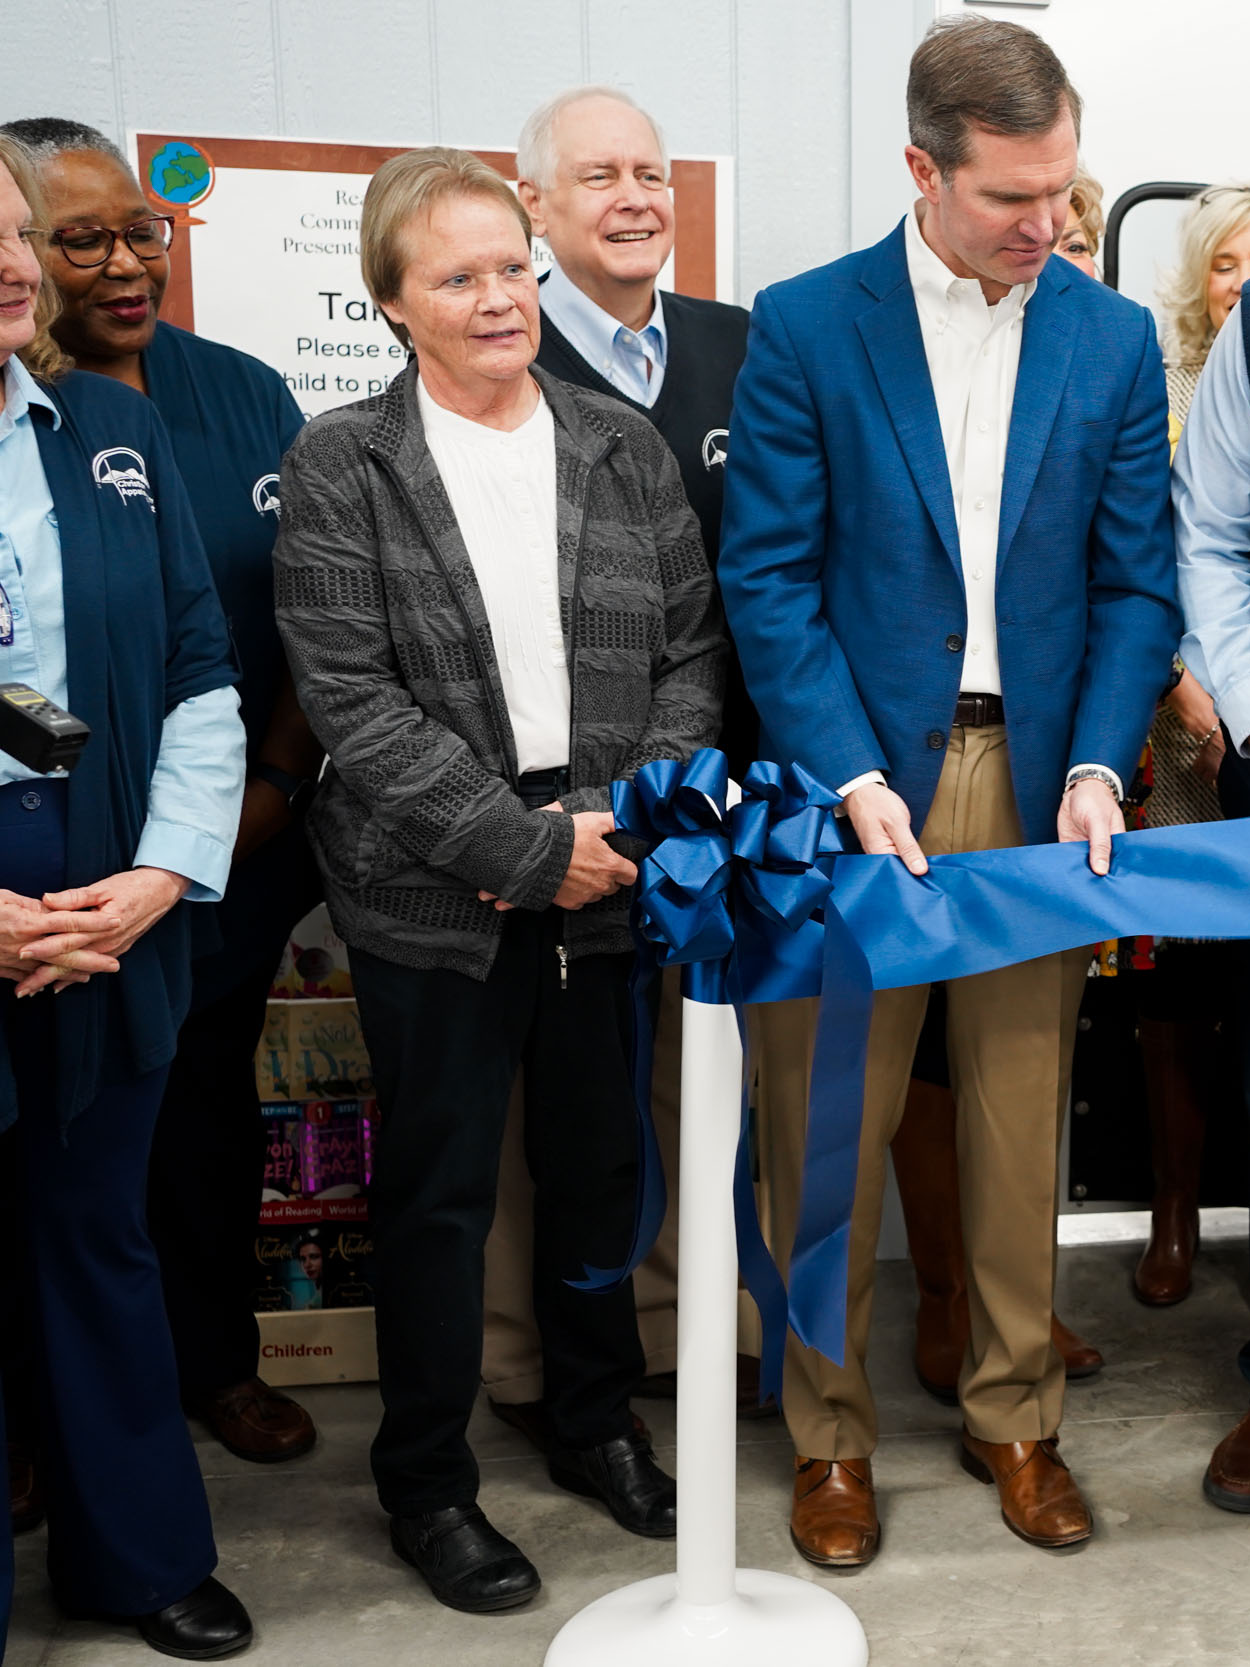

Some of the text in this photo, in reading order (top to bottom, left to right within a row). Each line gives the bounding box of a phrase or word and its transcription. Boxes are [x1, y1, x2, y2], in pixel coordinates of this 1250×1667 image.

[297, 337, 380, 358] Please
[335, 375, 360, 392] to
[316, 1106, 323, 1120] 1
[274, 1207, 284, 1217] of
[285, 1205, 322, 1218] Reading
[329, 1204, 357, 1216] World
[261, 1343, 334, 1358] Children
